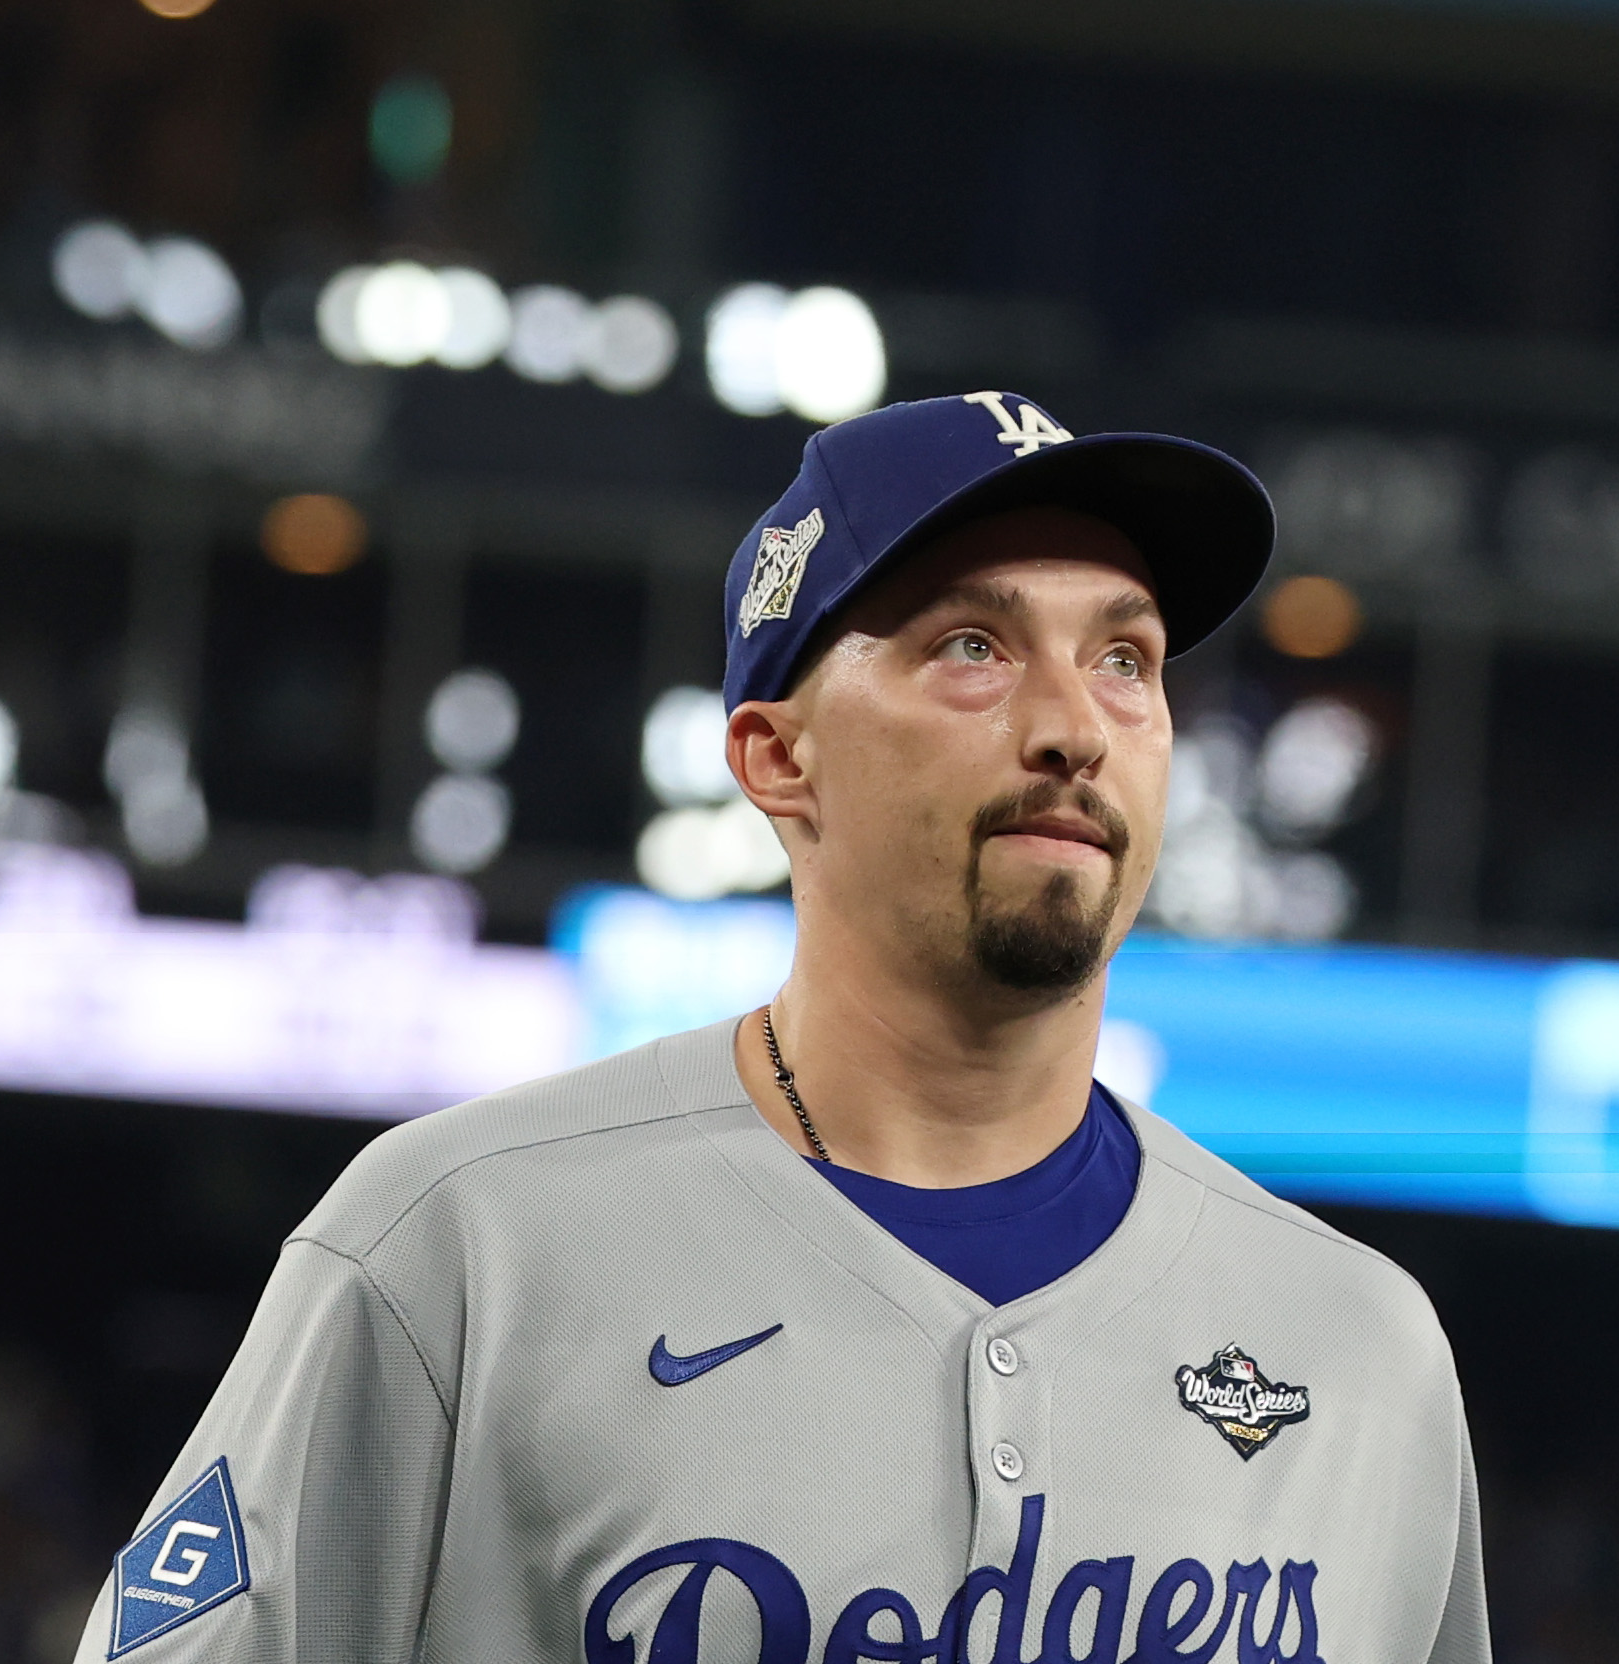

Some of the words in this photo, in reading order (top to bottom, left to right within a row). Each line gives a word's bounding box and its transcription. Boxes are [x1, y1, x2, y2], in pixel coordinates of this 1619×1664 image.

[963, 391, 1074, 457] LA
[1182, 1371, 1246, 1408] World
[1238, 1382, 1306, 1425] Series
[150, 1519, 221, 1586] G
[123, 1586, 196, 1609] GUGGENHEIM
